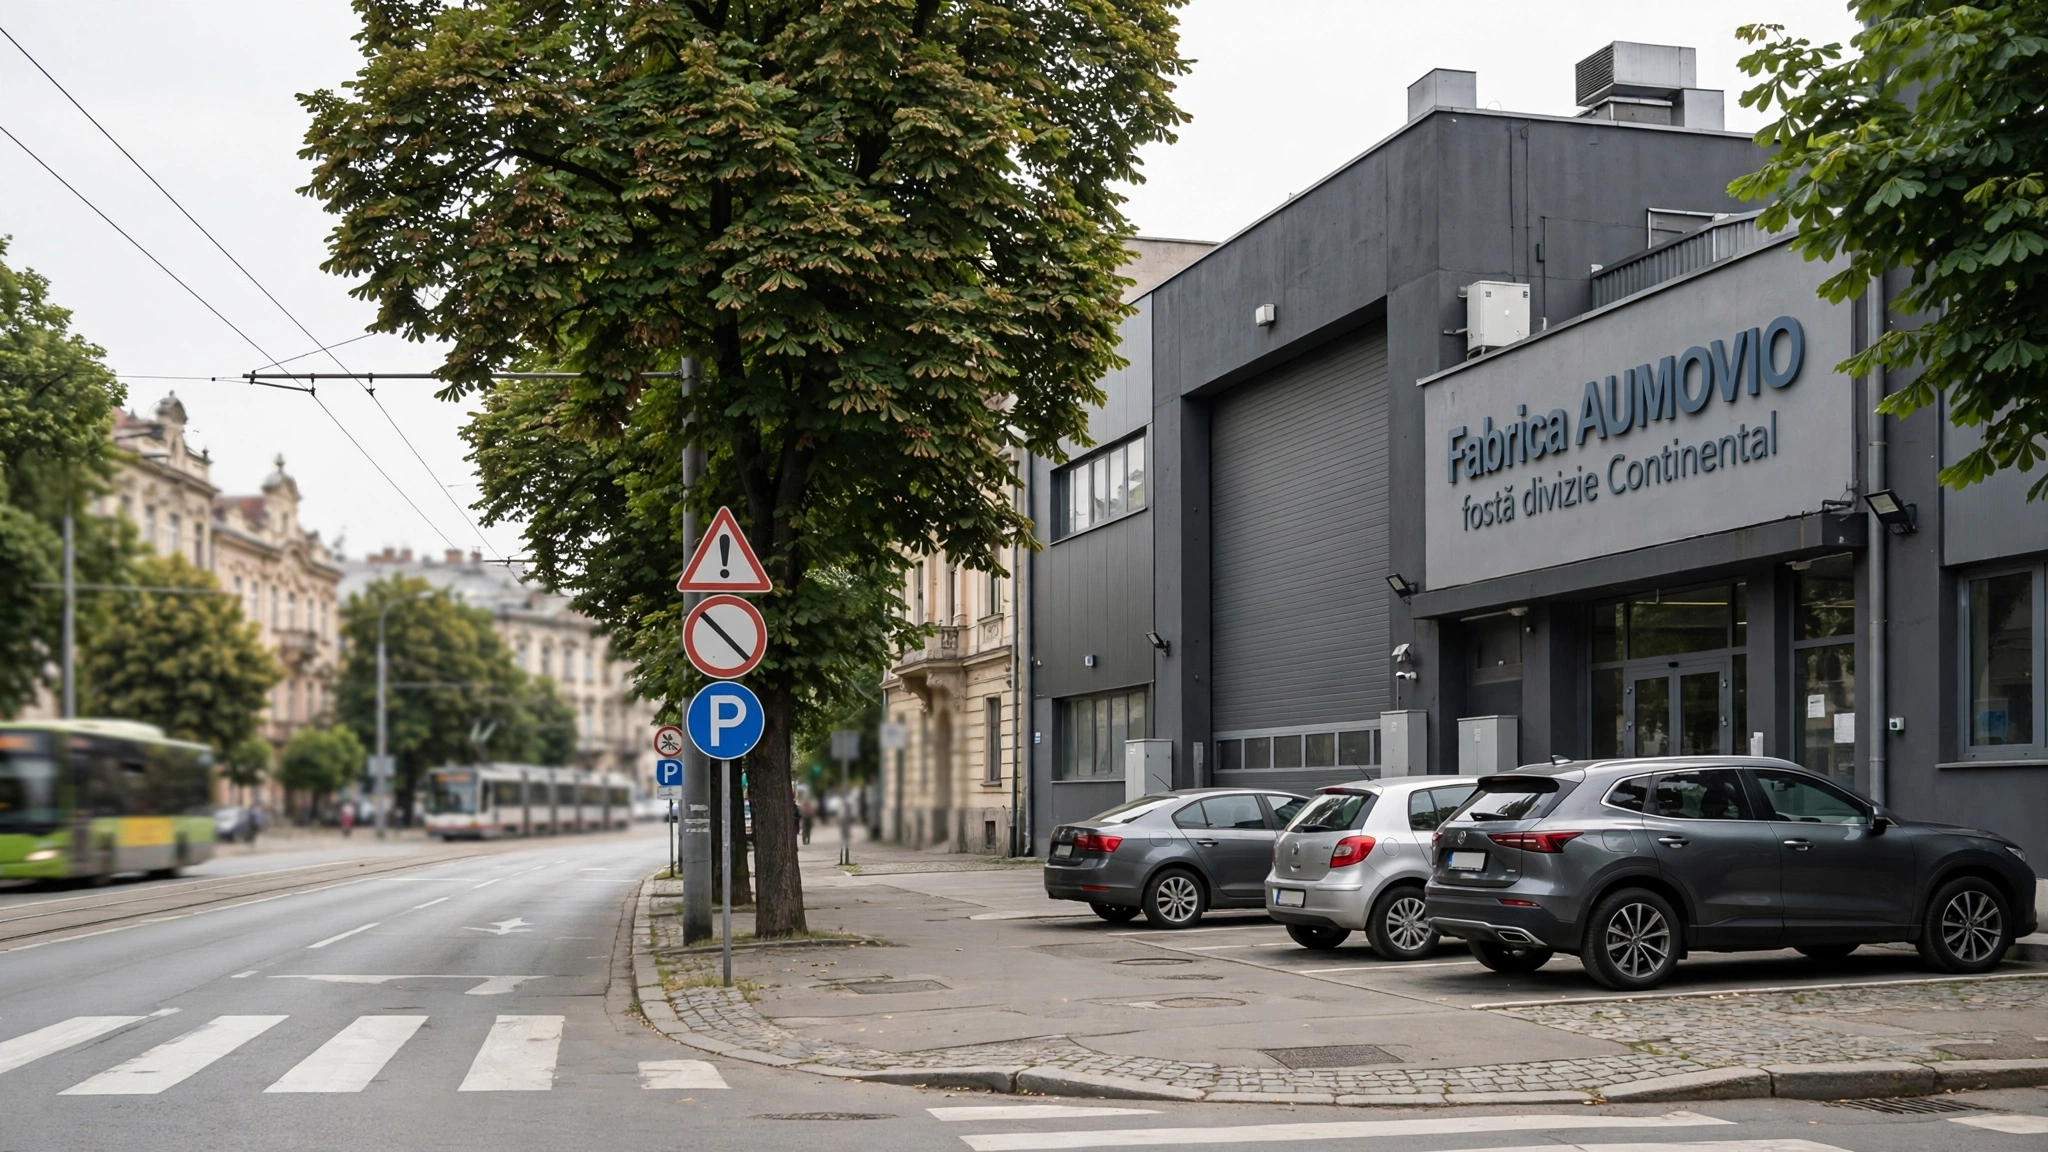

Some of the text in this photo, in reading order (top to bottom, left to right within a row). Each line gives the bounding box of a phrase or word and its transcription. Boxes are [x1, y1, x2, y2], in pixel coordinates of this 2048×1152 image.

[1447, 315, 1806, 484] Fabrica AUMOVIO
[1462, 409, 1778, 531] fostă divizie Continental
[710, 695, 747, 747] P
[664, 763, 678, 784] P
